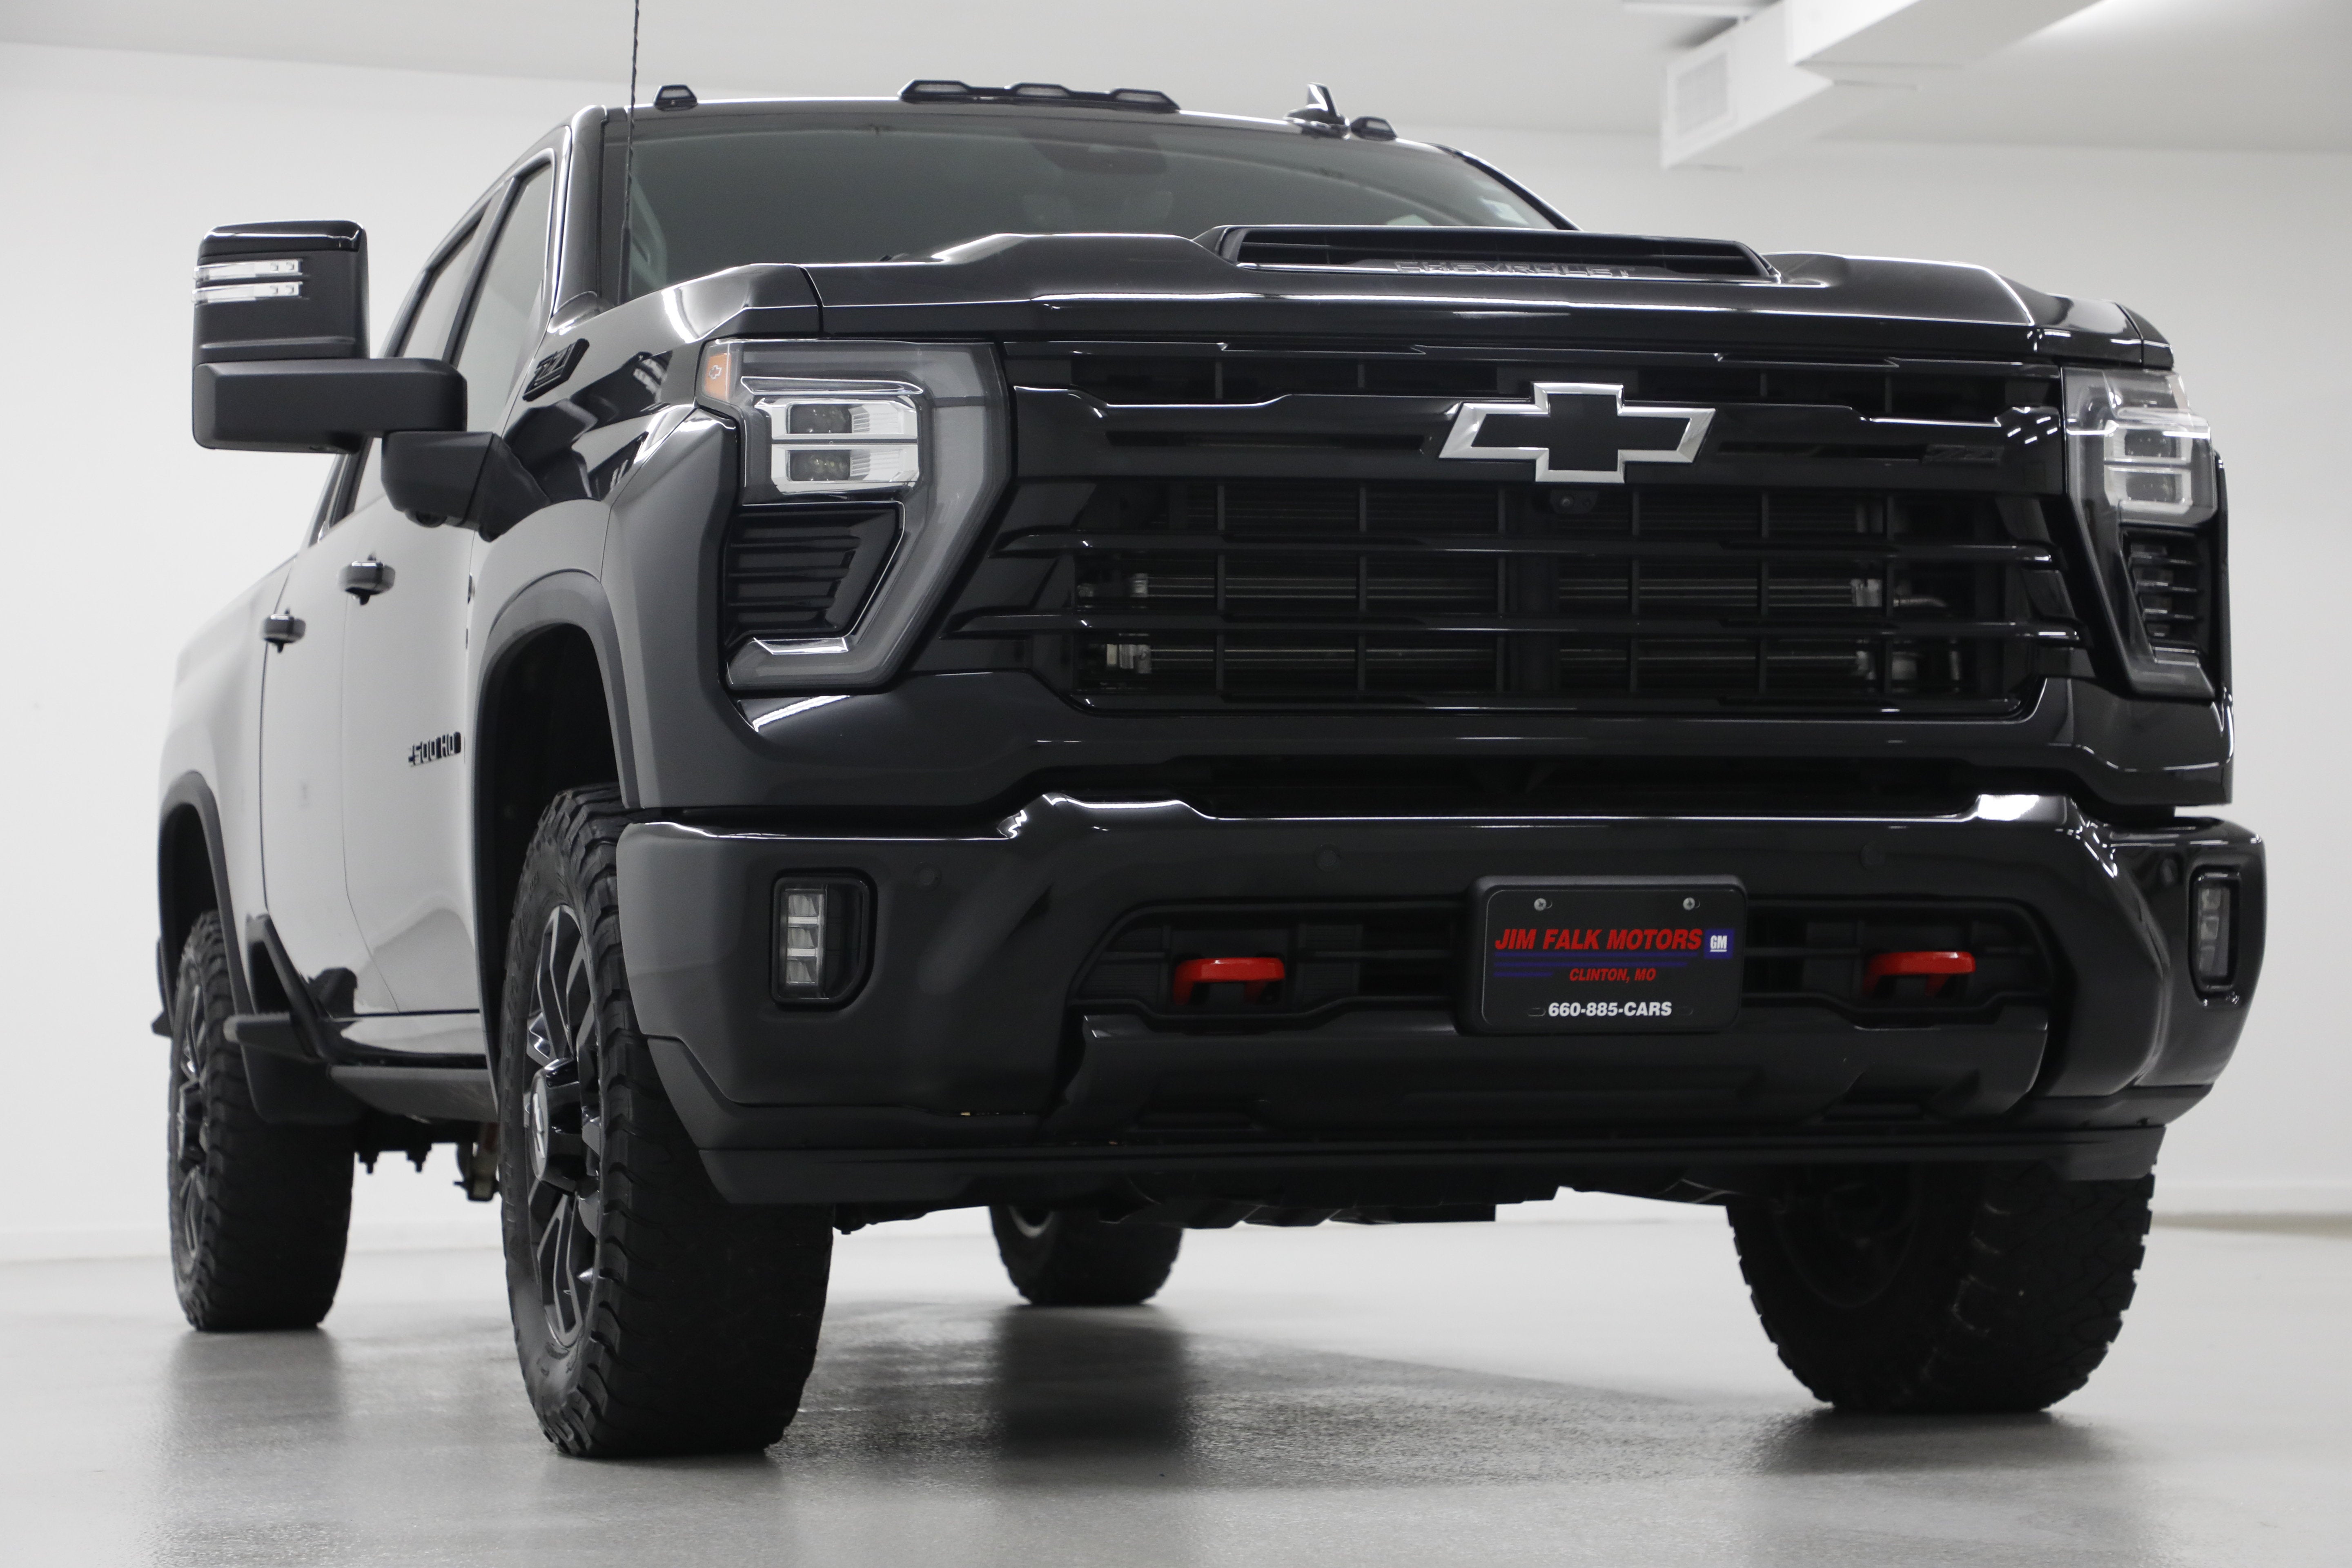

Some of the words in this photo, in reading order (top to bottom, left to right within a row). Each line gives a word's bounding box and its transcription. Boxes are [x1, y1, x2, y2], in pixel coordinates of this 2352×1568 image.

[1394, 261, 1635, 276] CHEVROLET
[1494, 929, 1537, 950] JIM
[1542, 929, 1602, 950] FALK
[1606, 929, 1703, 950] MOTORS
[1710, 935, 1728, 952] GM
[1569, 968, 1630, 983] CLINTON,
[1634, 968, 1656, 981] MO
[1548, 1001, 1673, 1017] 660-885-CARS
